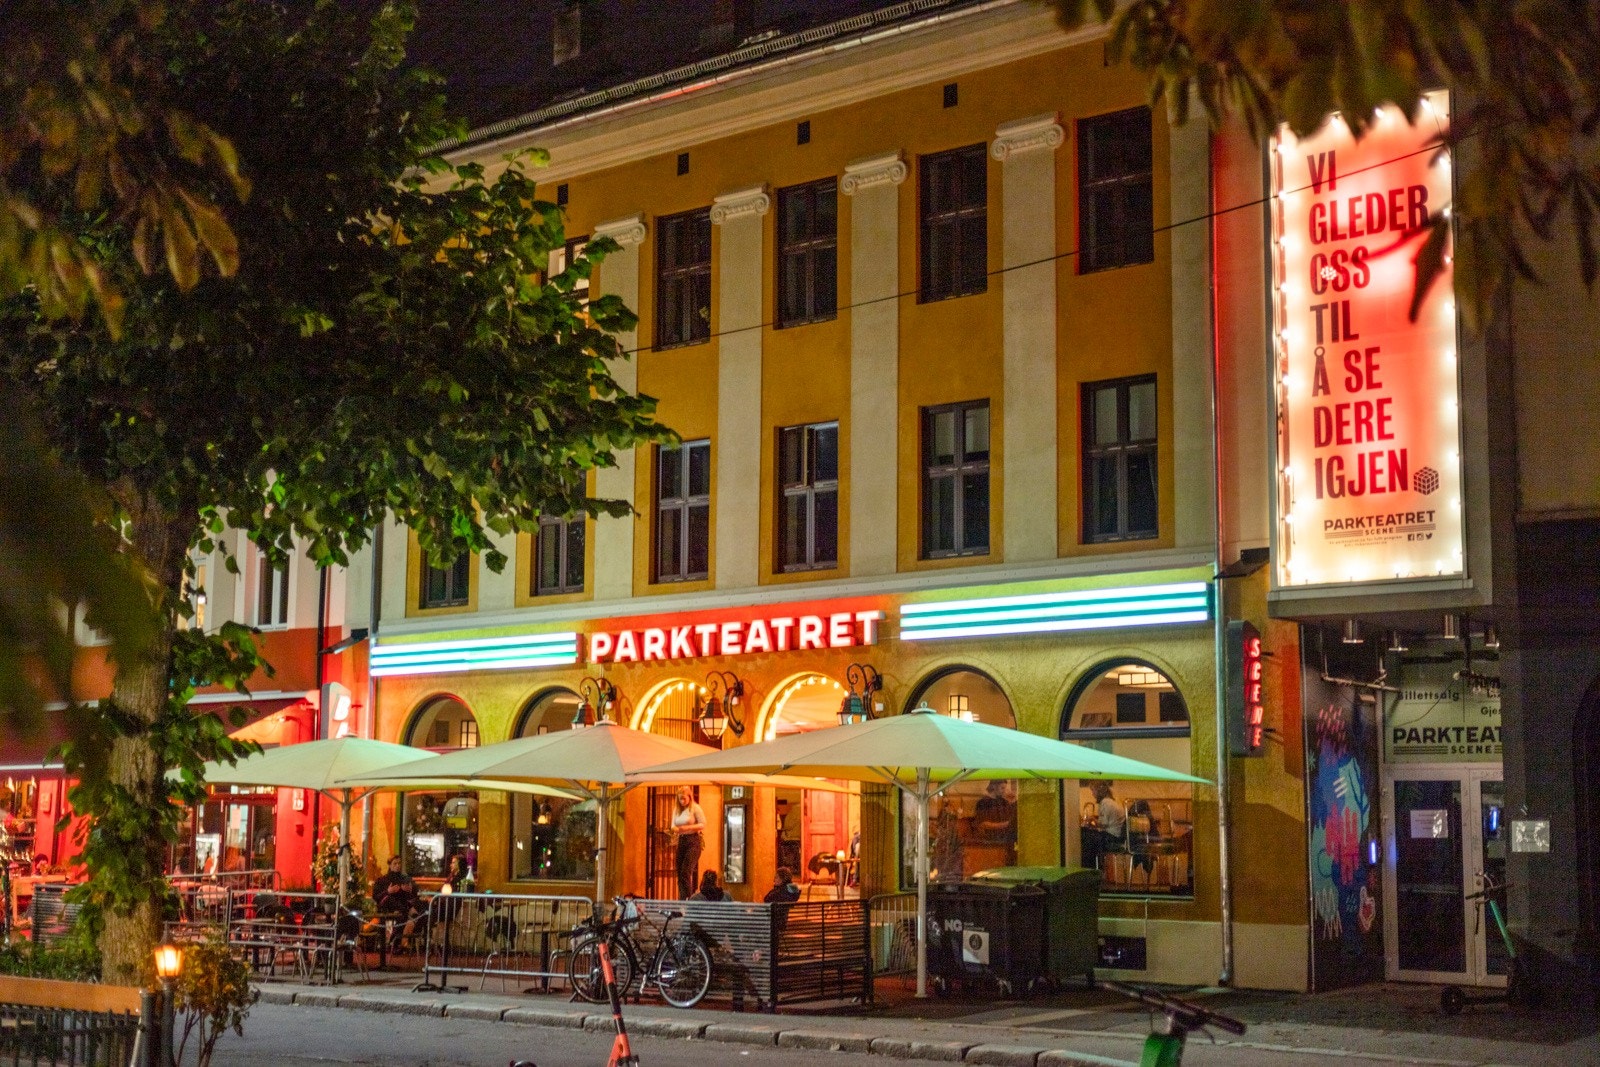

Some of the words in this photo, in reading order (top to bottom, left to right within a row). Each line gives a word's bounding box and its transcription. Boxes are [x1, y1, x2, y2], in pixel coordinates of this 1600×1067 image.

[1307, 150, 1337, 195] VI
[1308, 184, 1429, 245] GLEDER
[1309, 245, 1370, 296] OSS
[1309, 300, 1360, 345] TIL
[1312, 346, 1331, 397] Å
[1343, 346, 1383, 393] SE
[1313, 397, 1395, 448] DERE
[1314, 448, 1409, 499] IGJEN
[1324, 510, 1436, 531] PARKTEATRET
[1364, 527, 1394, 536] SCENE
[590, 610, 882, 664] PARKTEATRET
[1249, 637, 1263, 747] SCENE
[1450, 745, 1493, 754] SCENE
